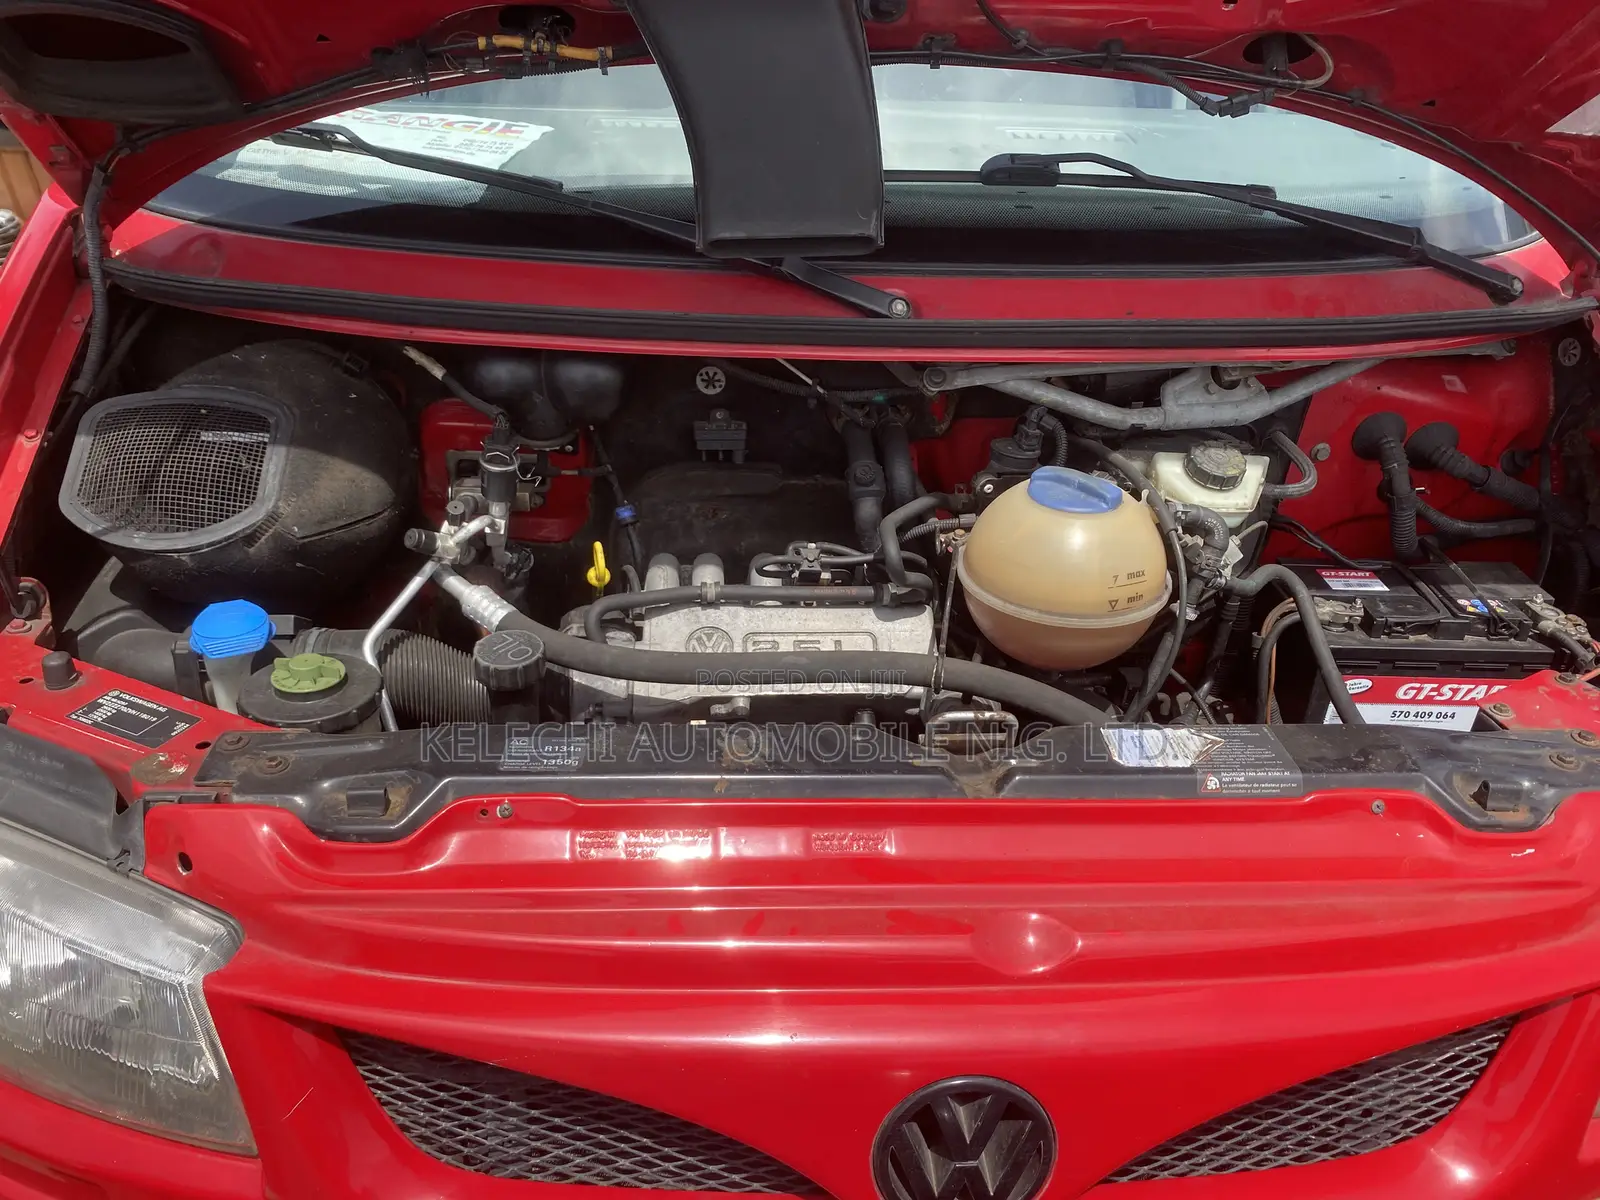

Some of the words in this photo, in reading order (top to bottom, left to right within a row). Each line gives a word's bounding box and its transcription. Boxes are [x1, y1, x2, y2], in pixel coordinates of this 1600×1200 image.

[1127, 569, 1145, 580] max
[1127, 592, 1144, 604] min
[493, 634, 532, 660] OIL
[119, 693, 159, 709] VOLKSWAGEN
[1390, 710, 1410, 718] 570
[1412, 710, 1433, 719] 409
[1436, 712, 1456, 720] 064
